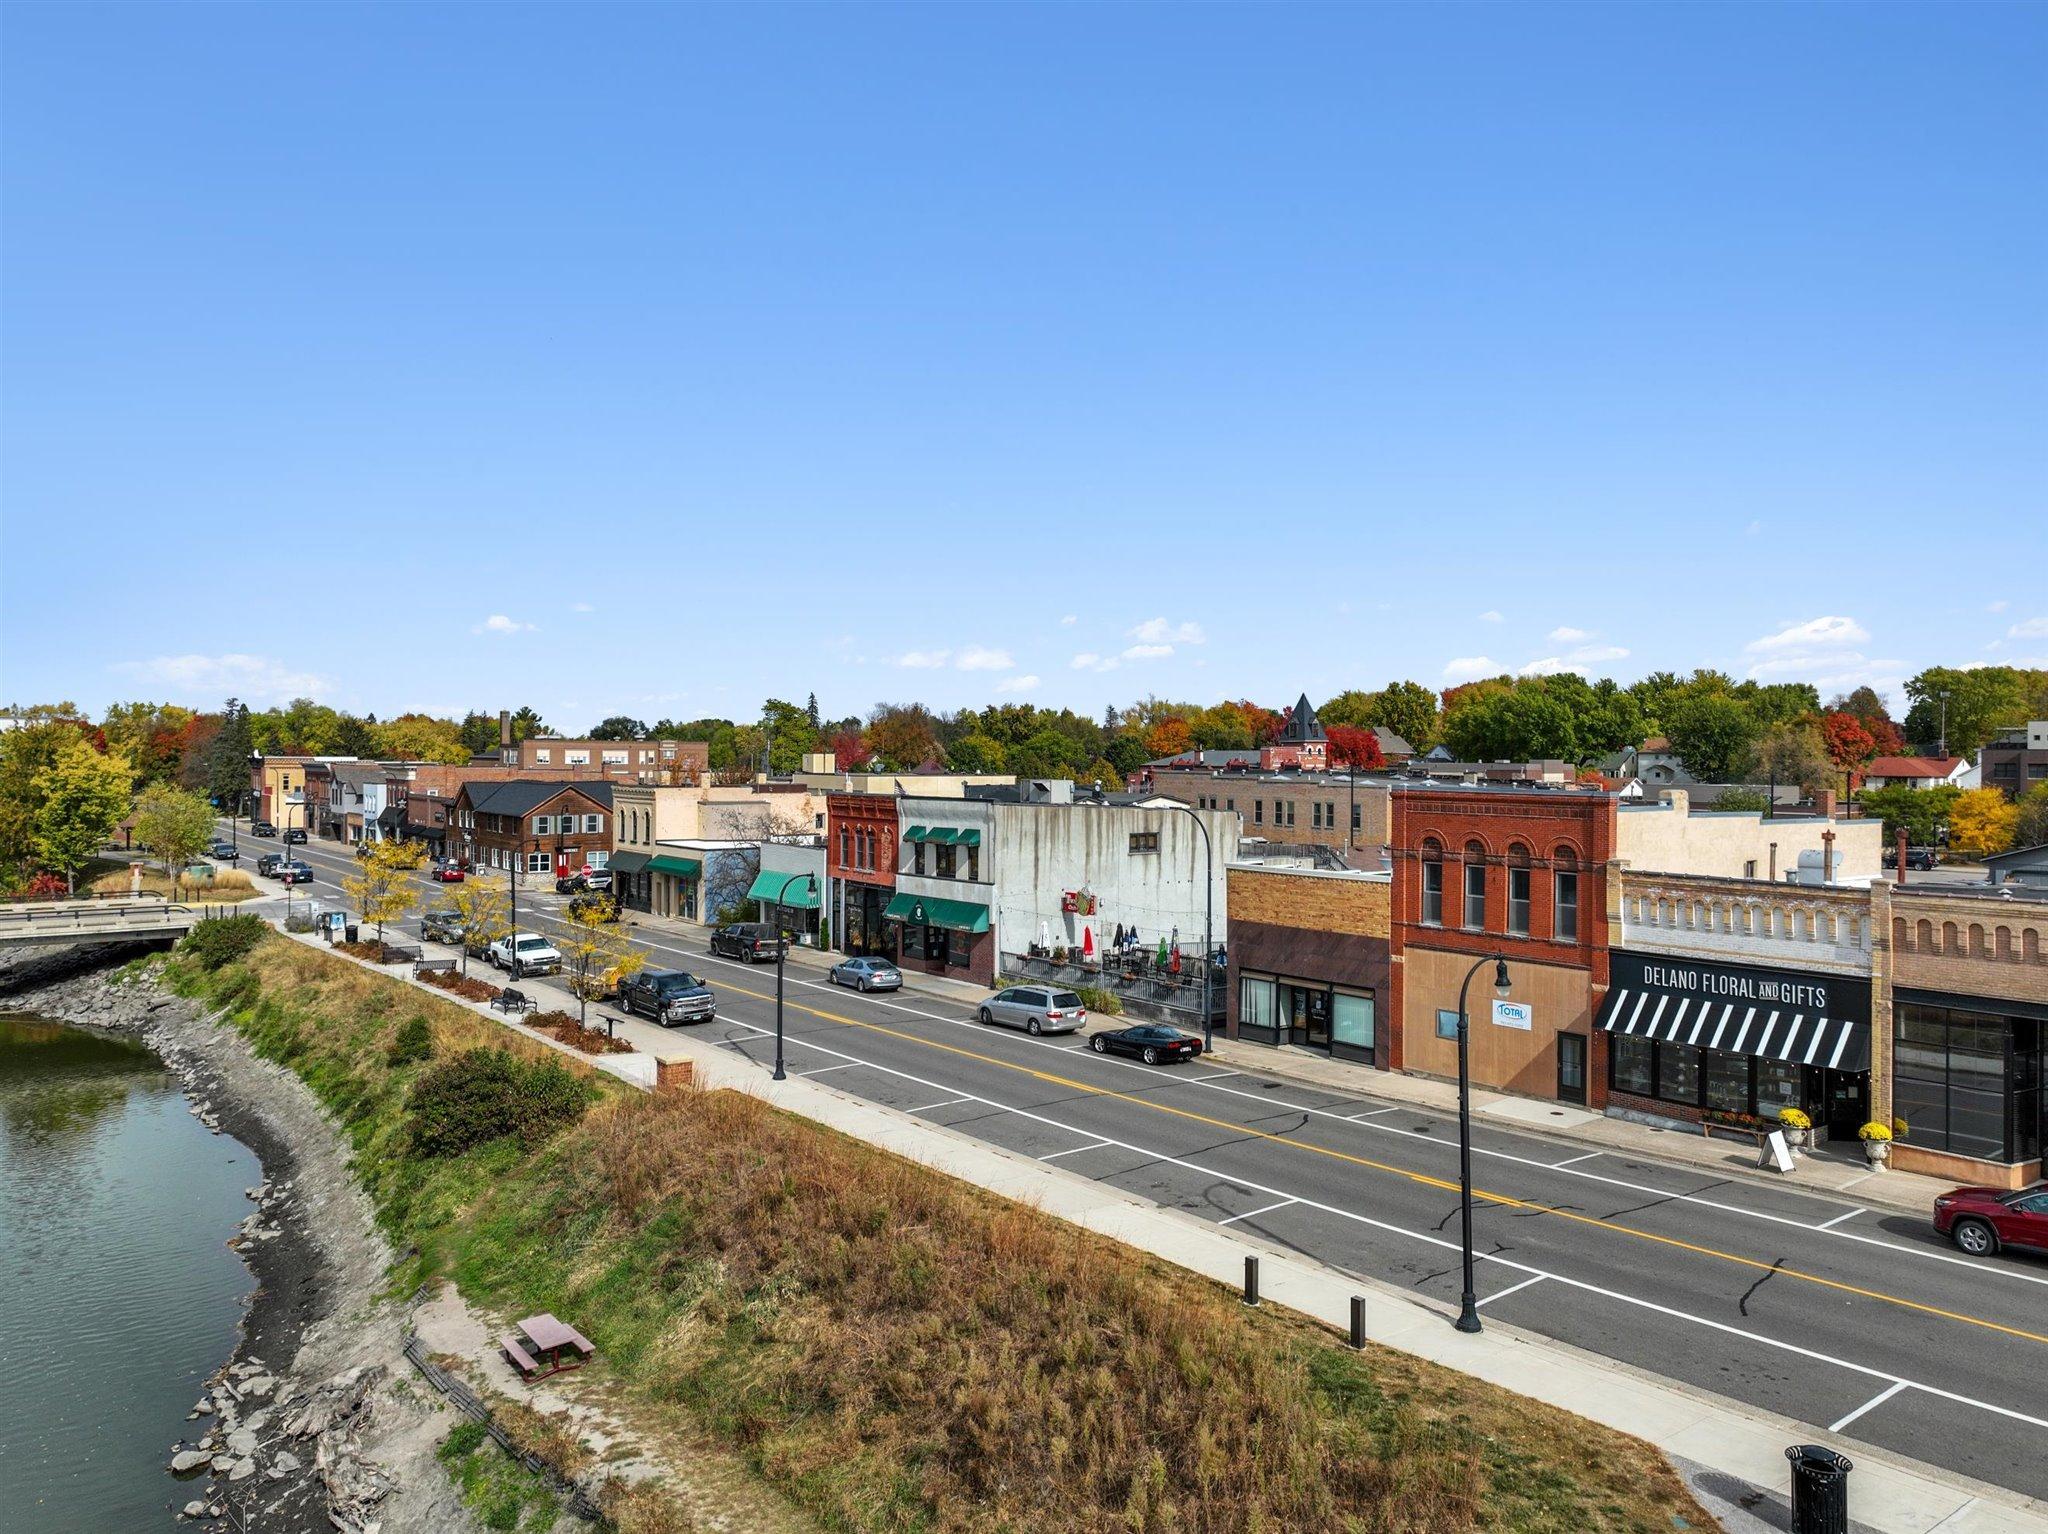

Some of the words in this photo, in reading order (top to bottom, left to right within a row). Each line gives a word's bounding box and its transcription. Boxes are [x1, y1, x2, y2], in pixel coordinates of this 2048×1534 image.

[1644, 966, 1697, 990] DELANO
[1702, 973, 1757, 999] FLORAL
[1758, 984, 1779, 998] AND
[1781, 983, 1825, 1008] GIFTS
[1498, 1003, 1523, 1019] TOTAL
